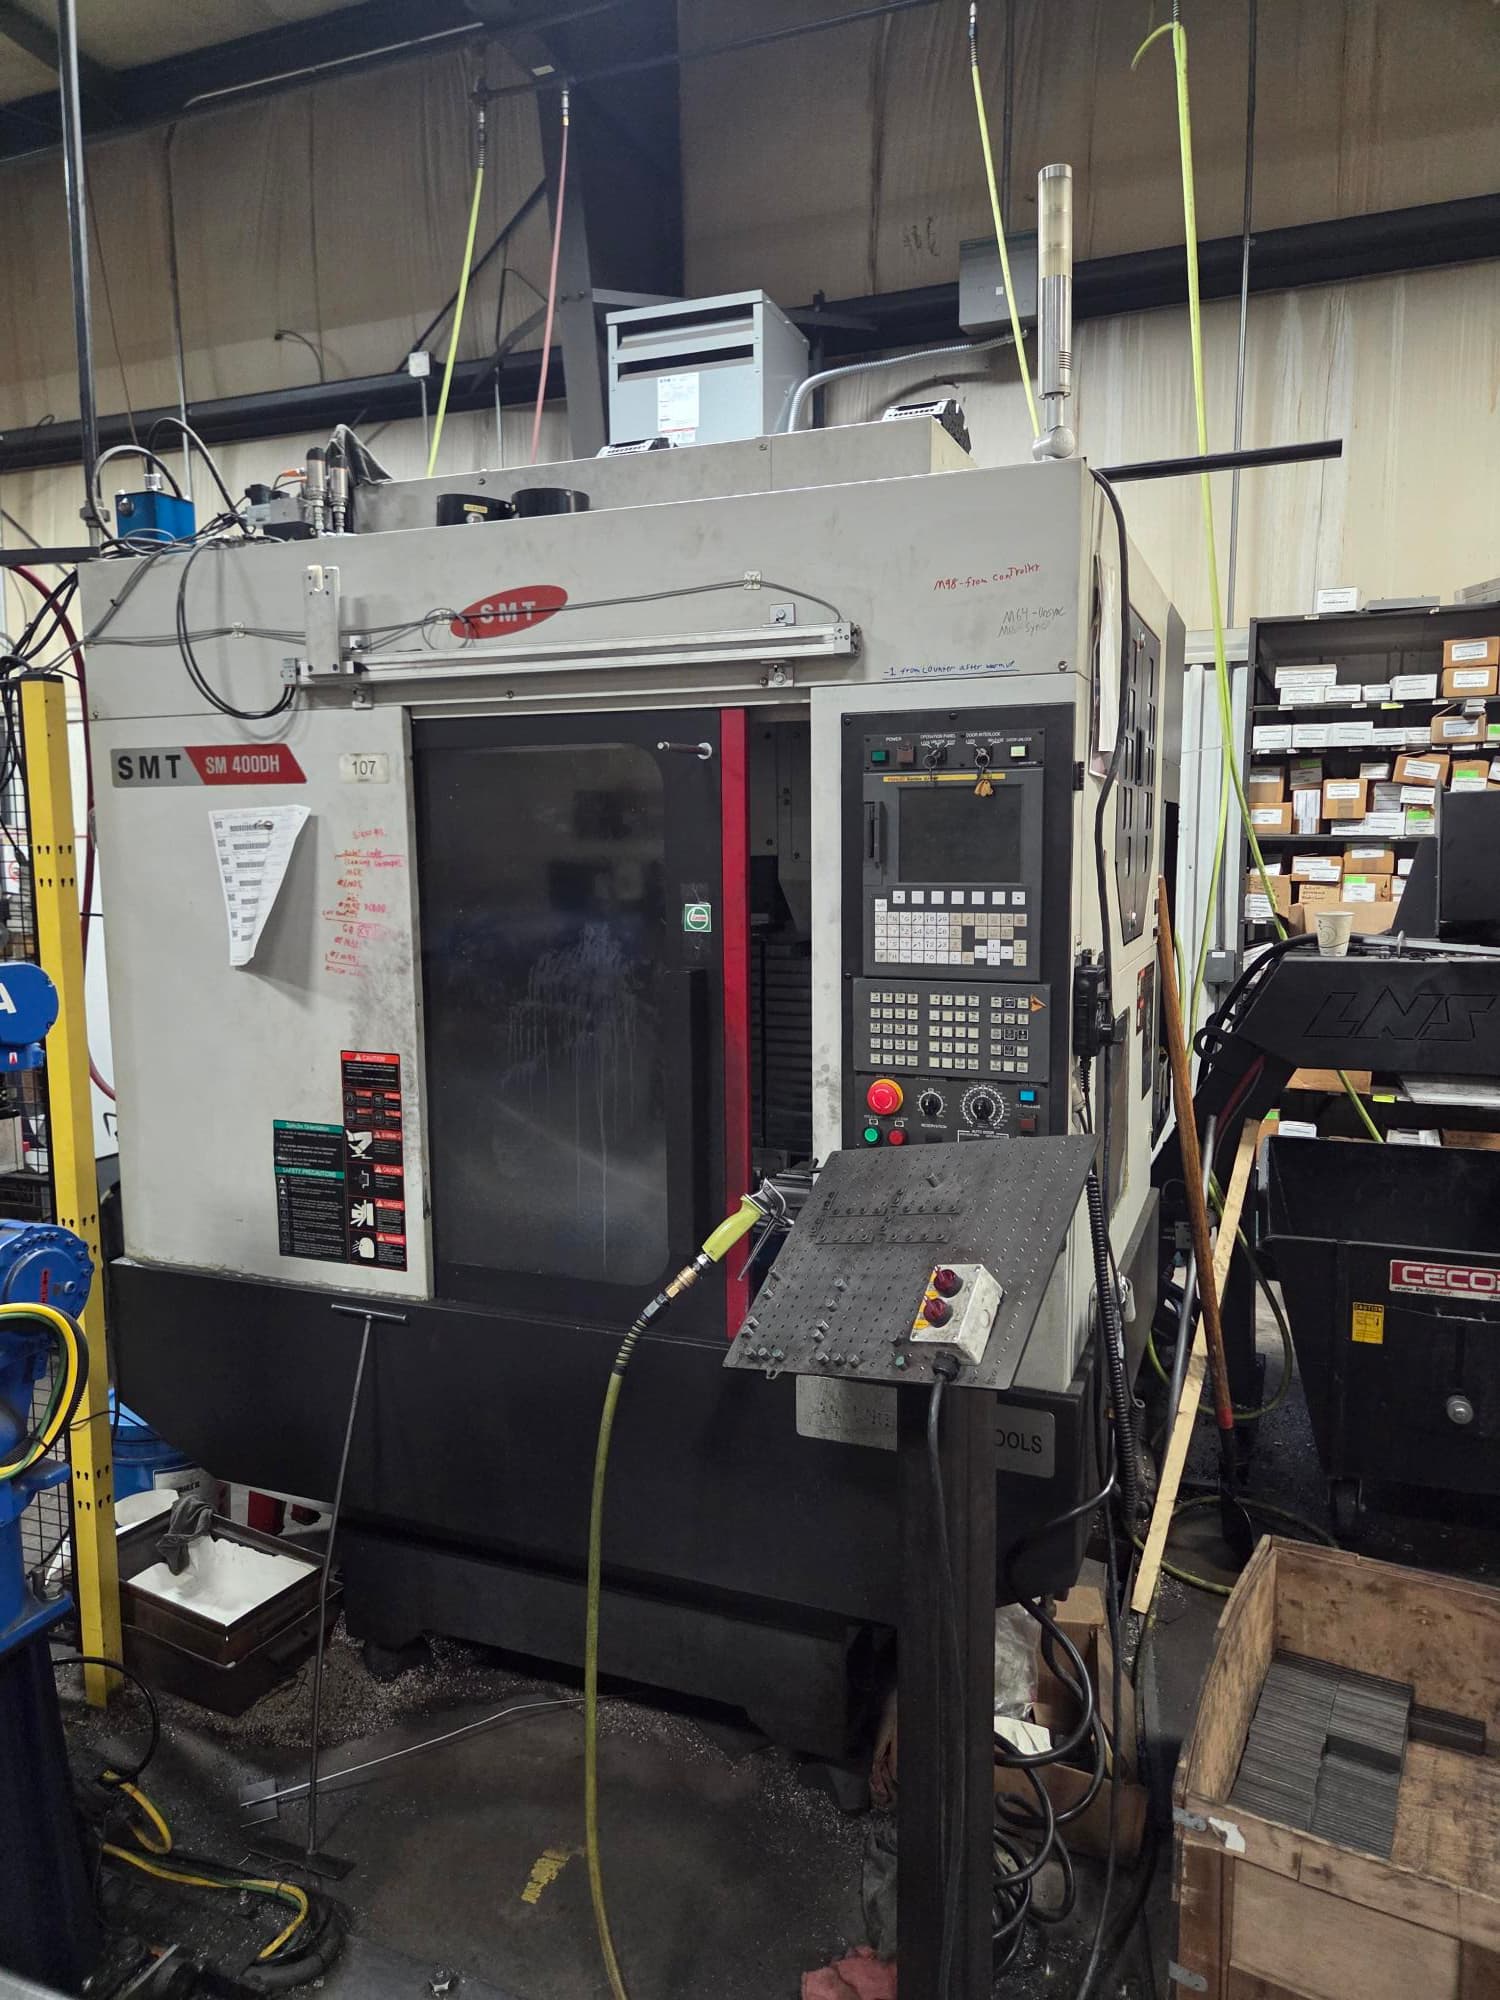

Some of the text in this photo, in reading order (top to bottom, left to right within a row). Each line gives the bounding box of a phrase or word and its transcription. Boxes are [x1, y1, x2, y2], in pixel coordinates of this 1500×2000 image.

[479, 600, 537, 624] SMT
[900, 666, 921, 675] from
[117, 754, 181, 780] SMT
[205, 755, 280, 775] SM 400DH
[351, 760, 376, 775] 107
[1401, 1265, 1500, 1295] CECO
